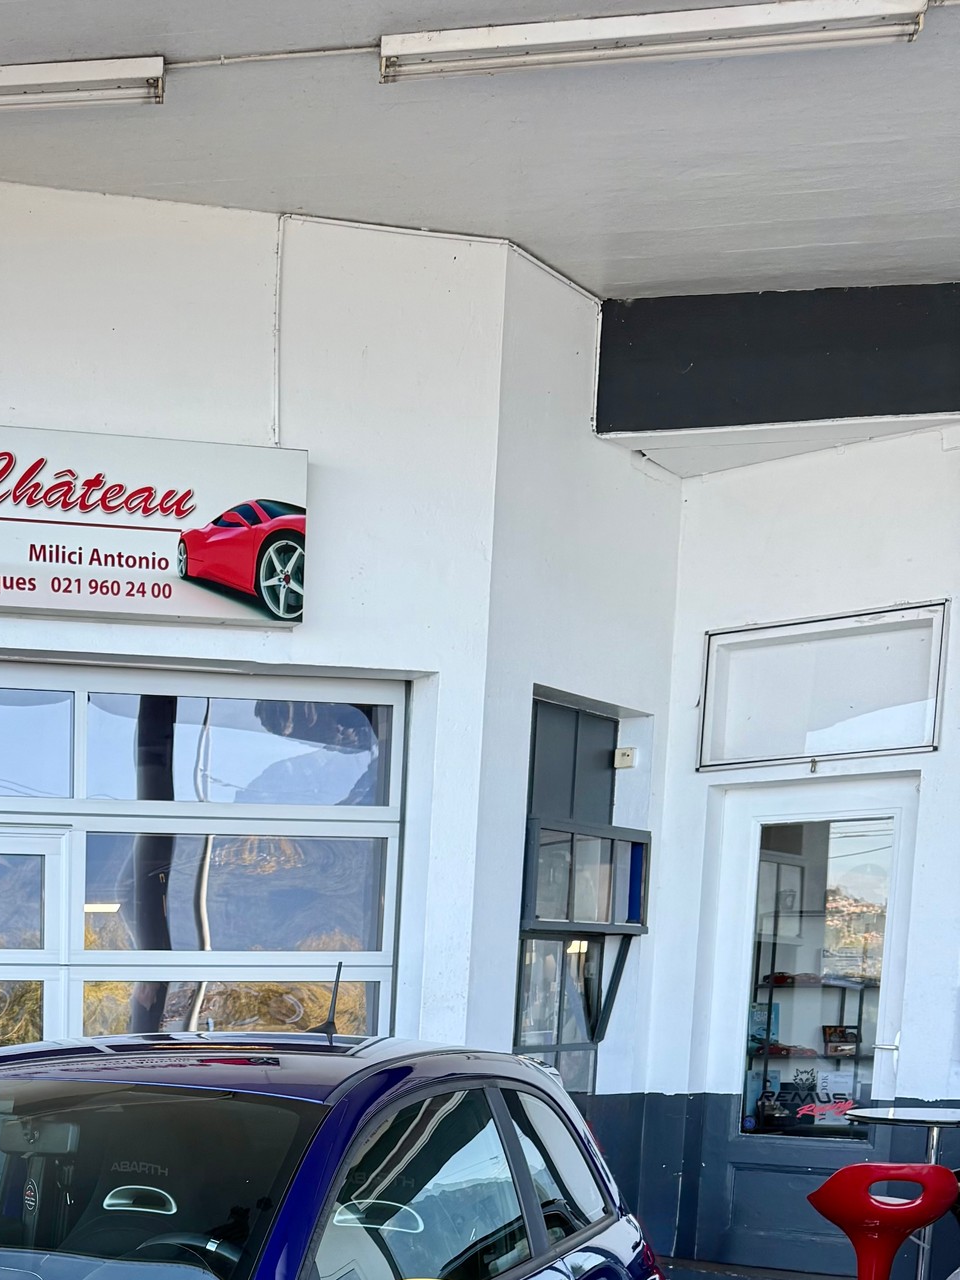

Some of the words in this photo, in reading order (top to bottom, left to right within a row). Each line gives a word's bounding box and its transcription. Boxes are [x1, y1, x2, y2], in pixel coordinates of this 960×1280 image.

[28, 543, 84, 566] Milici
[88, 547, 170, 571] Antonio
[50, 576, 82, 595] 021
[88, 577, 122, 597] 960
[125, 580, 148, 599] 24
[150, 582, 173, 600] 00
[757, 1090, 849, 1105] REMUS
[110, 1160, 169, 1177] ABARTH
